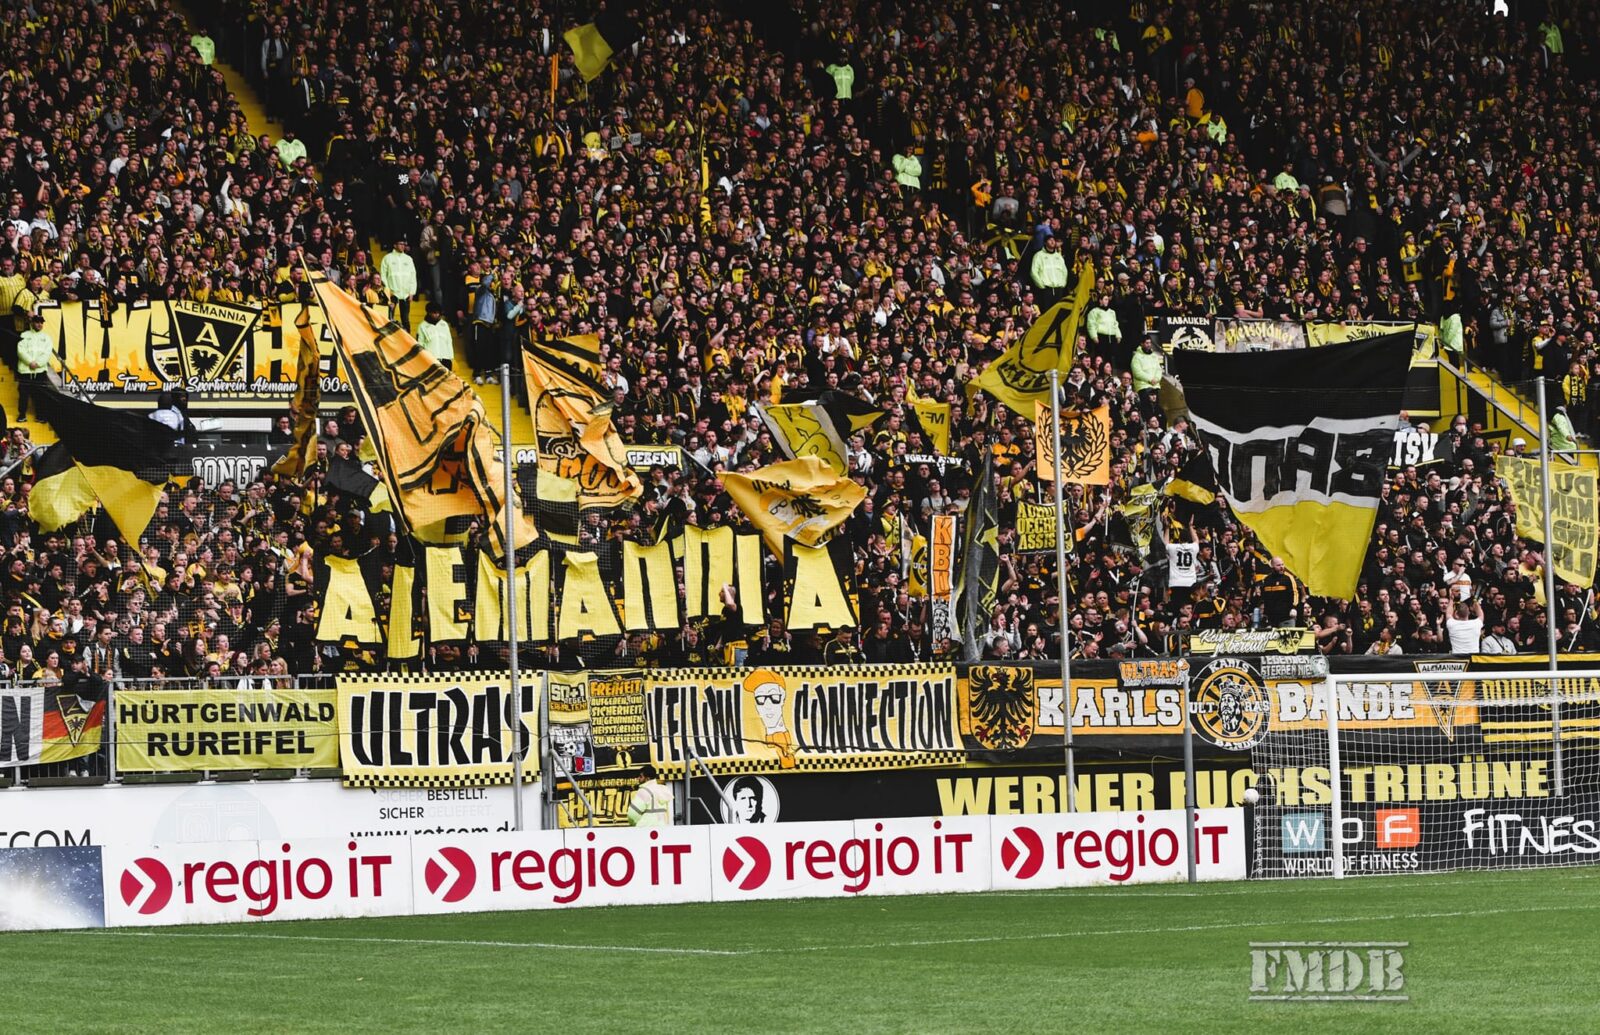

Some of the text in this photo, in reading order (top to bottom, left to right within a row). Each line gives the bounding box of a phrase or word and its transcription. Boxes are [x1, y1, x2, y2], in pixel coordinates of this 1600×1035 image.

[175, 300, 248, 324] ALEMANNIA
[1167, 316, 1210, 326] RABAUKEN
[118, 374, 156, 394] Turn-
[162, 377, 182, 392] und
[251, 376, 298, 392] Alemann
[1388, 432, 1438, 466] TSV
[1176, 550, 1193, 567] 10
[316, 525, 856, 659] ALEMANNIA
[1120, 660, 1178, 680] ULTRAS
[1208, 658, 1250, 674] KARLS
[1261, 656, 1310, 665] LEGENDEN
[1261, 665, 1298, 676] STERBEN
[1421, 664, 1463, 673] ALEMANNIA
[590, 680, 641, 697] FREIHEIT
[120, 699, 335, 724] HÜRTGENWALD
[592, 705, 643, 717] SICHERHEIT
[1037, 686, 1183, 727] KARLS
[1277, 682, 1416, 722] BANDE
[351, 685, 535, 766] ULTRAS
[646, 683, 746, 763] YELLOW
[794, 677, 956, 754] CONNECTION
[147, 730, 315, 757] RUREIFEL
[427, 788, 488, 801] BESTELLT.
[936, 772, 1155, 816] WERNER
[1343, 754, 1549, 803] TRIBÜNE
[379, 806, 425, 820] SICHER
[568, 786, 635, 819] HALTU
[785, 822, 920, 893] regio
[1056, 814, 1180, 882] regio
[490, 831, 635, 903] regio
[1283, 856, 1333, 875] WORLD
[1360, 852, 1419, 870] FITNESS
[184, 842, 334, 918] regio
